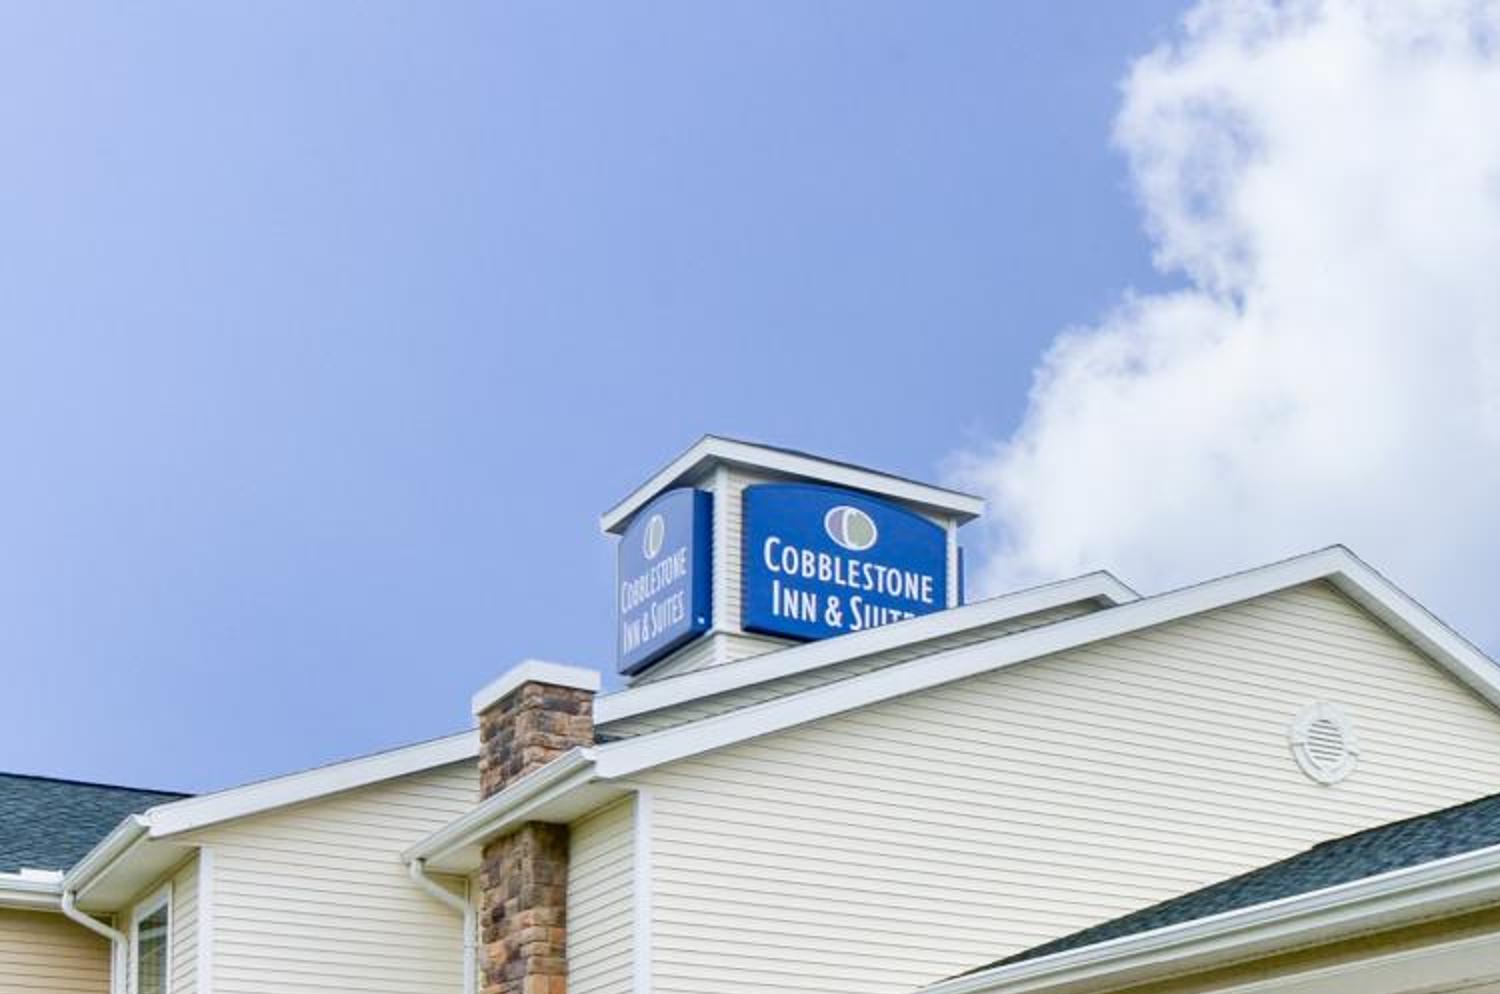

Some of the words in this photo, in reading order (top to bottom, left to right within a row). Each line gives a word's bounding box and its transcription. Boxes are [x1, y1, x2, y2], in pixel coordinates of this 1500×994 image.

[622, 546, 687, 613] COBBLESTONE
[764, 536, 934, 604] COBBLESTONE
[623, 619, 641, 656] INN
[641, 611, 649, 642] &
[650, 591, 685, 638] SUITES
[773, 580, 817, 623] INN
[825, 595, 843, 628] &
